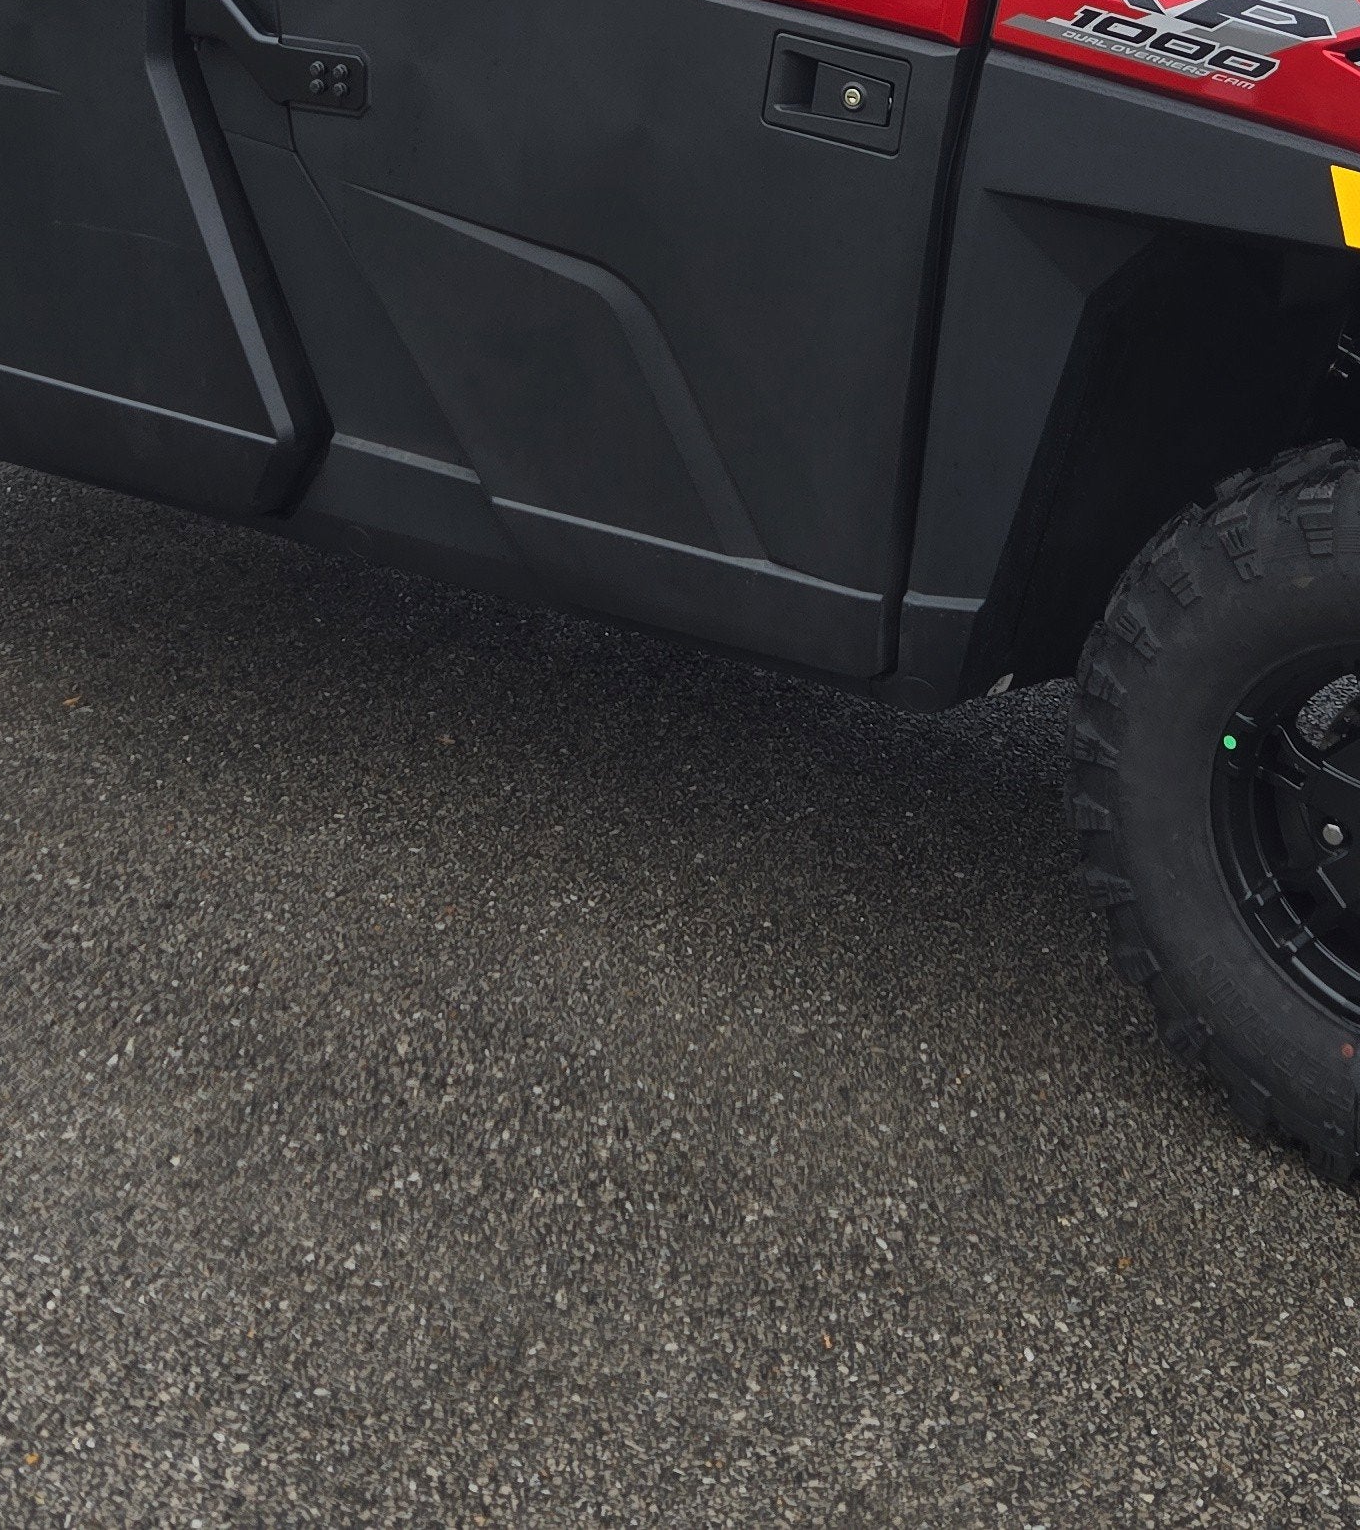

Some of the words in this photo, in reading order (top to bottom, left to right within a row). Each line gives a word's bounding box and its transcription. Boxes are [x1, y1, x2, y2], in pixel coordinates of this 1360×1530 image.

[1061, 30, 1108, 50] DUAL
[1110, 44, 1211, 78] OVERHEAD
[1210, 73, 1256, 91] CAM
[1070, 5, 1280, 82] 1000
